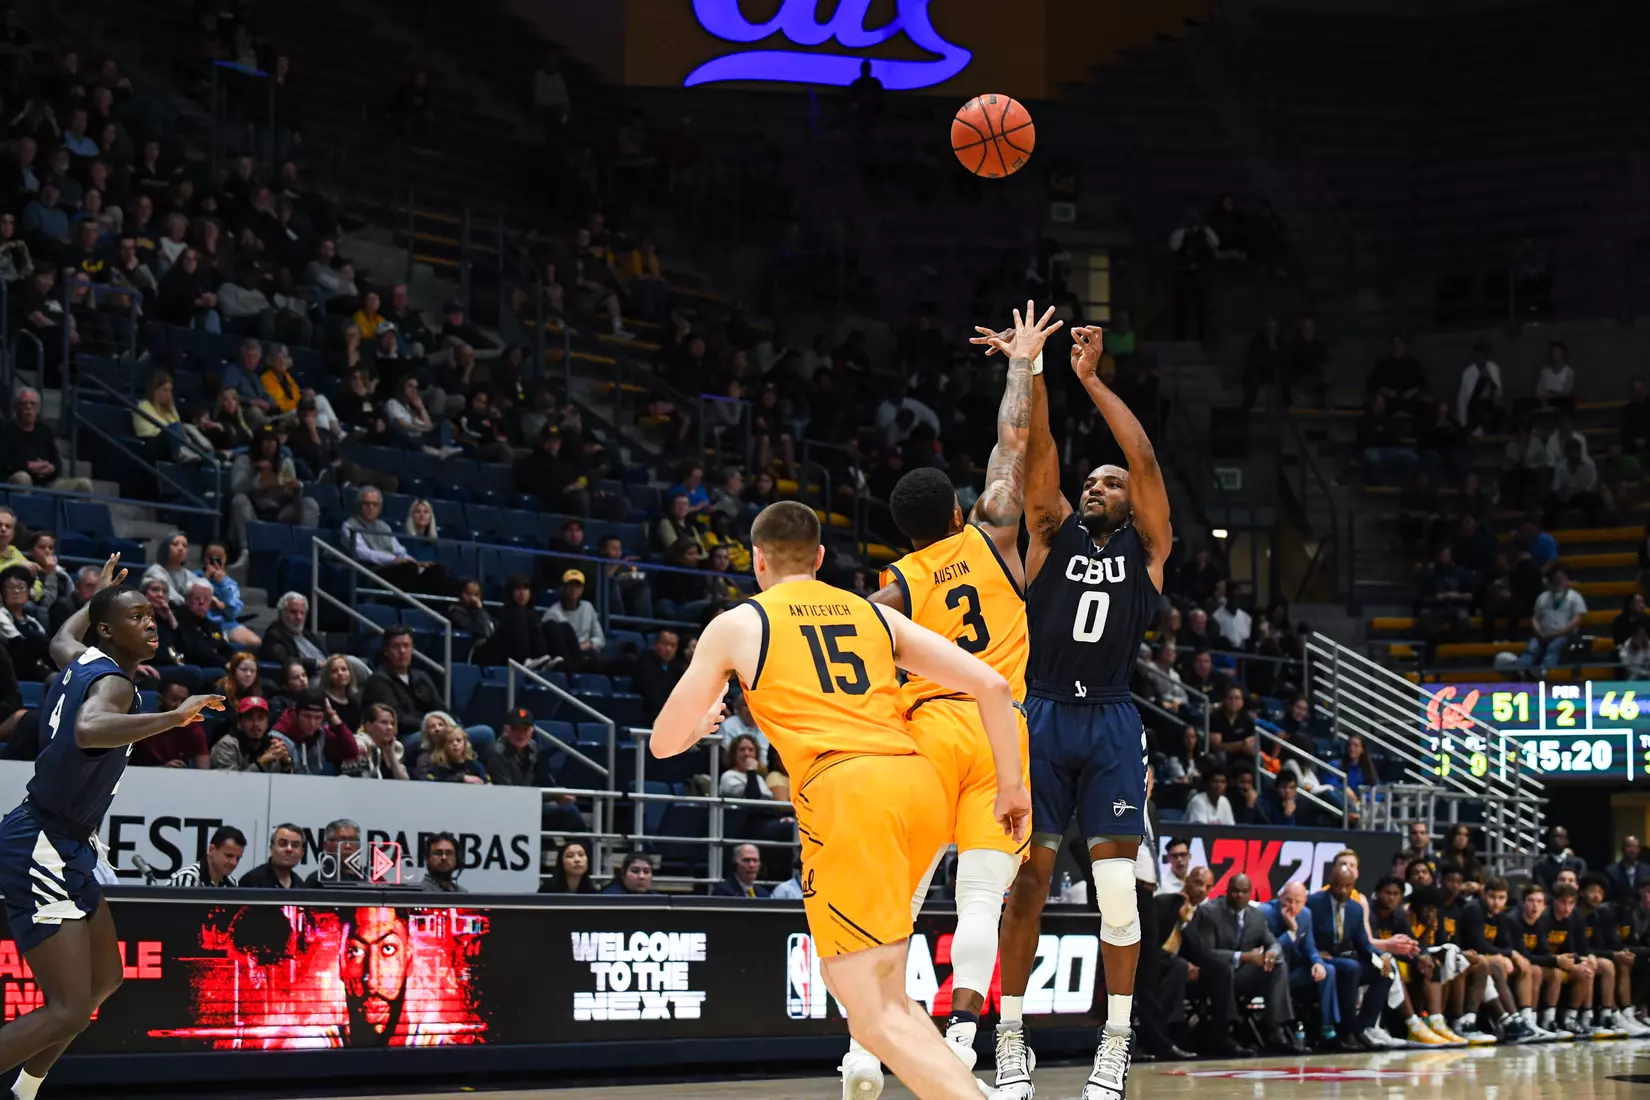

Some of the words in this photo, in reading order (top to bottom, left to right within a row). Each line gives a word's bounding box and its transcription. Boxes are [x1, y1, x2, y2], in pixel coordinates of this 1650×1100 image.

[934, 561, 970, 585] AUSTIN
[1065, 555, 1126, 584] CBU
[789, 604, 851, 617] ANTICEVICH
[945, 584, 991, 654] 3
[1072, 591, 1110, 643] 0
[799, 624, 870, 695] 15
[1492, 692, 1529, 722] 51
[1552, 685, 1580, 699] PER
[1599, 690, 1640, 721] 46
[49, 693, 66, 739] 4
[1556, 700, 1575, 726] 2
[1521, 739, 1612, 772] 15:20
[107, 815, 223, 880] EST
[367, 829, 531, 872] PABAS
[803, 868, 817, 898] al
[571, 931, 706, 962] WELCOME
[590, 961, 632, 992] TO
[632, 961, 689, 991] THE
[573, 991, 706, 1020] NEXT
